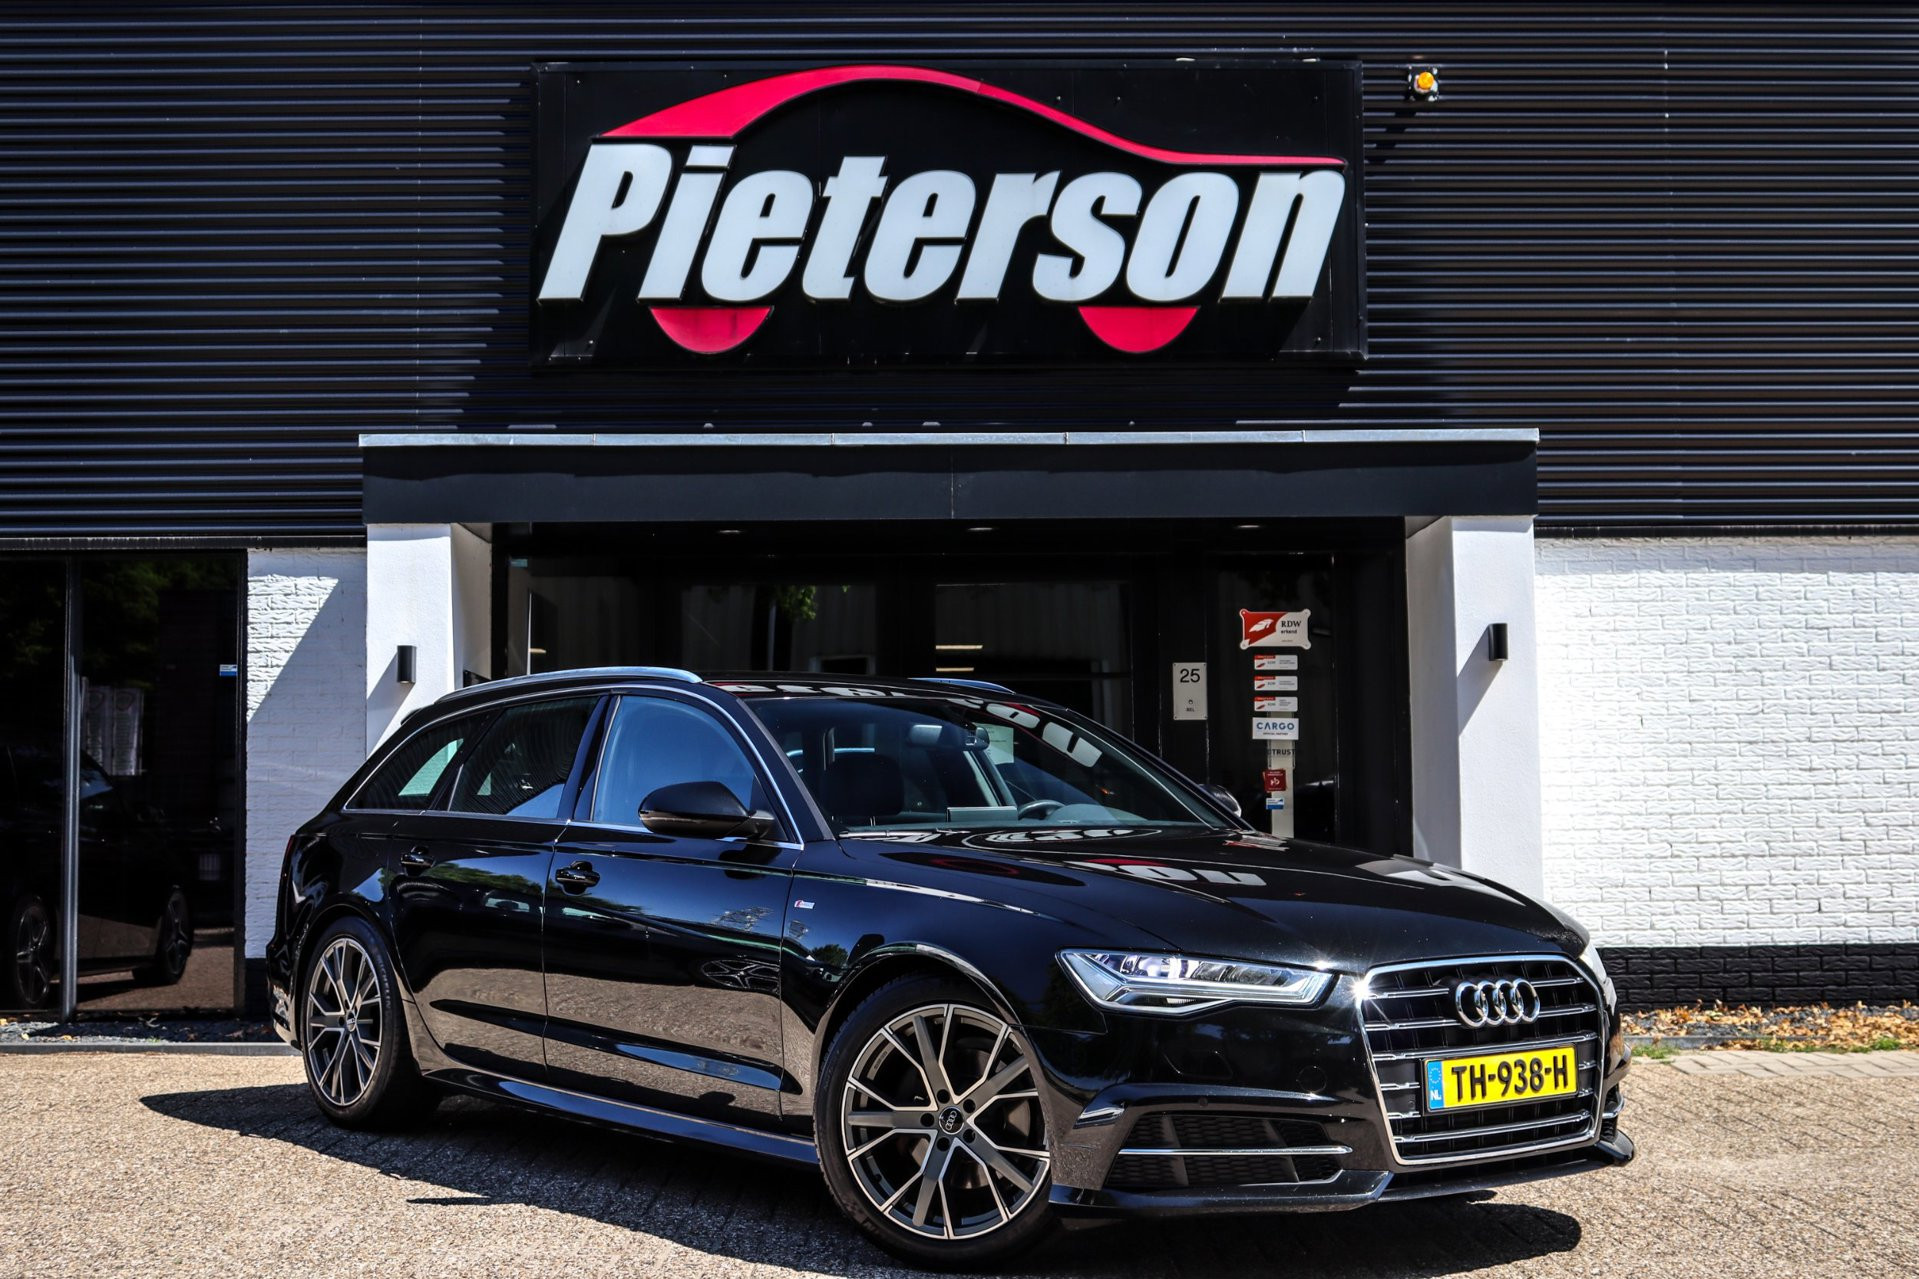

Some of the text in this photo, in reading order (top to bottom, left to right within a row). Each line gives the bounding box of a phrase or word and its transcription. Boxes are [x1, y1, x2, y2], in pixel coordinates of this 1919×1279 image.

[538, 144, 1346, 302] Pieterson
[1281, 620, 1301, 628] RDW
[1180, 668, 1200, 683] 25
[1256, 722, 1295, 730] CARGO
[1452, 1054, 1569, 1102] TH-938-H
[1430, 1090, 1442, 1101] NL
